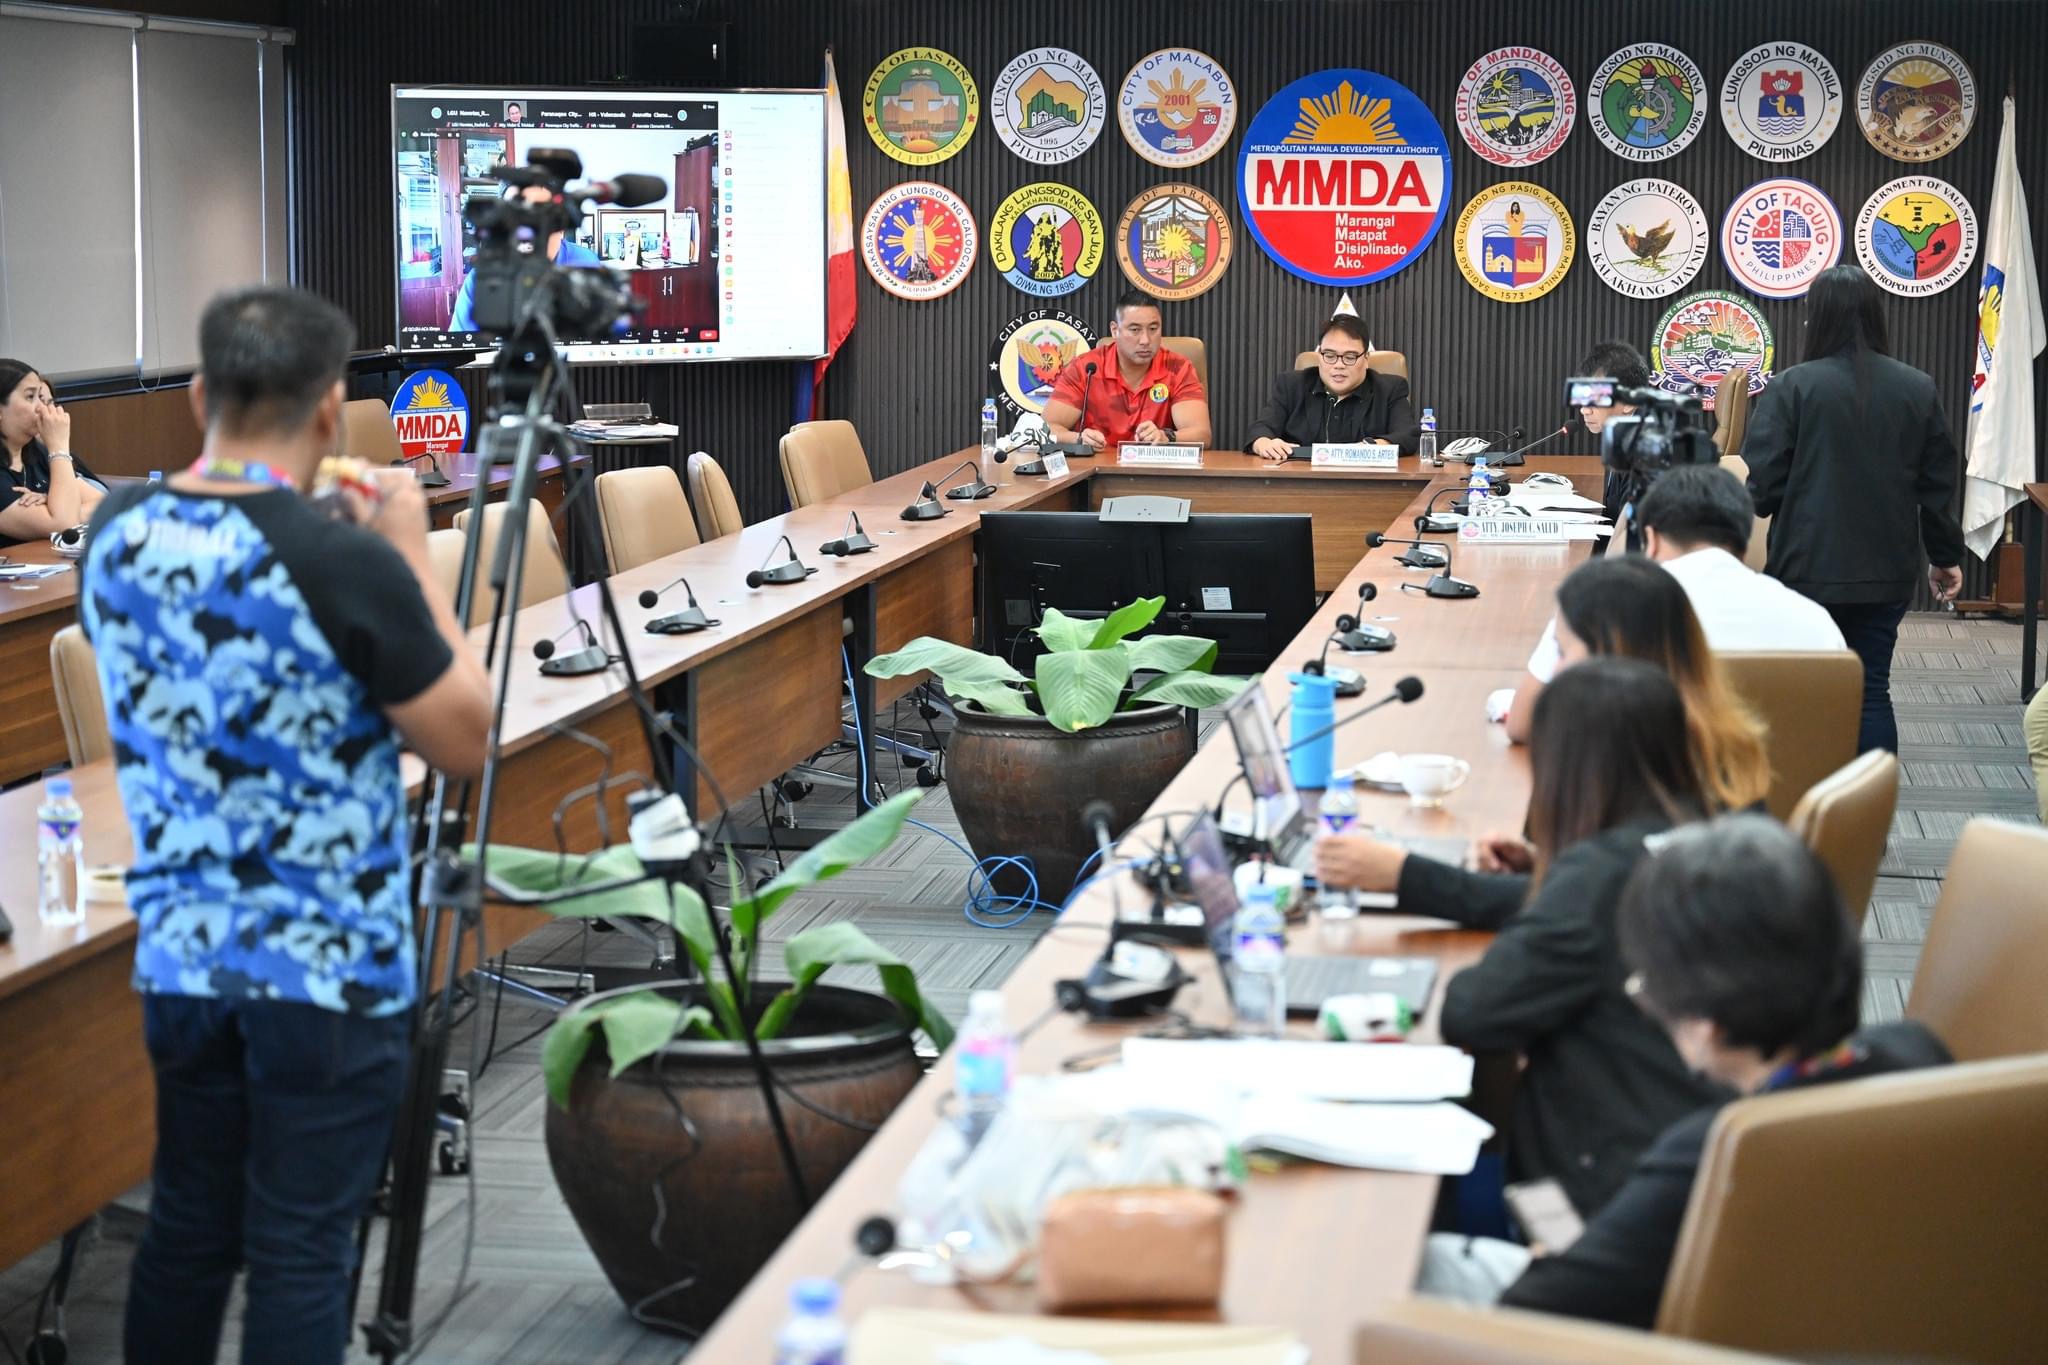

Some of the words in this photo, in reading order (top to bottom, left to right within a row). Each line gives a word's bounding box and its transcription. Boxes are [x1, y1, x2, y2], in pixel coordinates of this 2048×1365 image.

[866, 68, 887, 107] CITY
[889, 52, 910, 66] OF
[914, 51, 944, 62] LAS
[946, 57, 977, 106] PIÑAS
[994, 52, 1038, 117] LUNGSOD
[1046, 51, 1067, 63] NG
[1073, 61, 1104, 120] MAKATI
[1123, 71, 1143, 106] CITY
[1144, 55, 1163, 71] OF
[1170, 52, 1232, 104] MALABON
[1458, 85, 1469, 122] CITY
[1467, 62, 1483, 81] OF
[1486, 48, 1575, 115] MANDALUYONG
[1591, 49, 1631, 98] LUNGSOD
[1635, 45, 1653, 54] NG
[1657, 46, 1703, 95] MARIKINA
[1725, 48, 1770, 102] LUNGSOD
[1776, 46, 1796, 56] NG
[1800, 50, 1838, 101] MAYNILA
[1861, 54, 1893, 110] LUNGSOD
[1896, 46, 1914, 55] NG
[1919, 45, 1974, 110] MUNTINLUPA
[1165, 95, 1190, 106] 2001
[873, 128, 968, 163] PHILIPPINES
[1396, 146, 1439, 154] AUTHORITY
[1592, 114, 1609, 139] 1630
[1614, 141, 1680, 159] PILIPINAS
[1686, 110, 1703, 136] 1996
[1748, 140, 1814, 159] PILIPINAS
[1010, 139, 1088, 162] PILIPINAS
[901, 187, 949, 202] LUNGSOD
[1013, 187, 1069, 204] LUNGSOD
[1257, 159, 1431, 206] MMDA
[1491, 185, 1505, 195] NG
[1511, 185, 1541, 197] PASIG,
[1927, 181, 1942, 190] OF
[950, 202, 963, 216] NG
[1011, 197, 1055, 220] KALAKHANG
[1058, 199, 1086, 224] MAYNILA
[1071, 195, 1086, 210] NG
[1120, 209, 1135, 241] CITY
[1142, 190, 1158, 202] OF
[1459, 194, 1488, 233] LUNGSOD
[1592, 192, 1621, 231] BAYAN
[1622, 183, 1641, 194] NG
[1647, 182, 1697, 216] PATEROS
[1862, 179, 1923, 223] GOVERNMENT
[994, 204, 1014, 262] DAKILANG
[1084, 209, 1098, 235] SAN
[1336, 213, 1395, 228] Marangal
[1545, 196, 1572, 251] KALAKHANG
[1735, 208, 1755, 245] CITY
[1756, 194, 1778, 210] OF
[1783, 193, 1828, 244] TAGUIG
[1944, 187, 1974, 250] VALENZUELA
[866, 194, 898, 276] MAKASAYSAYANG
[956, 219, 972, 276] CALOOCAN
[1335, 227, 1387, 242] Matapat
[1335, 241, 1407, 256] Disiplinado
[1457, 239, 1464, 253] NG
[1859, 228, 1867, 251] CITY
[1083, 239, 1100, 269] JUAN
[1334, 256, 1364, 269] Ako.
[1593, 253, 1665, 296] KALAKHANG
[1672, 231, 1706, 286] MAYNILA
[1746, 259, 1816, 280] PHILIPPINES
[1135, 275, 1180, 297] DEDICATED
[1460, 257, 1489, 291] SAGISAG
[1539, 256, 1569, 291] MAYNILA
[1866, 260, 1933, 293] METROPOLITAN
[1936, 261, 1966, 288] MANILA
[1040, 286, 1052, 294] NG
[1000, 316, 1025, 341] CITY
[1029, 310, 1047, 320] OF
[1057, 312, 1096, 341] PASAY
[1653, 310, 1675, 344] INTEGRITY
[1676, 292, 1721, 308] RESPONSIVE
[1728, 292, 1772, 344] SELF-SUFFICIENCY
[397, 414, 461, 440] MMDA
[1482, 522, 1499, 533] ATTY.
[1502, 522, 1526, 533] JOSEPH
[1529, 522, 1535, 533] C.
[1537, 522, 1558, 533] SALUD
